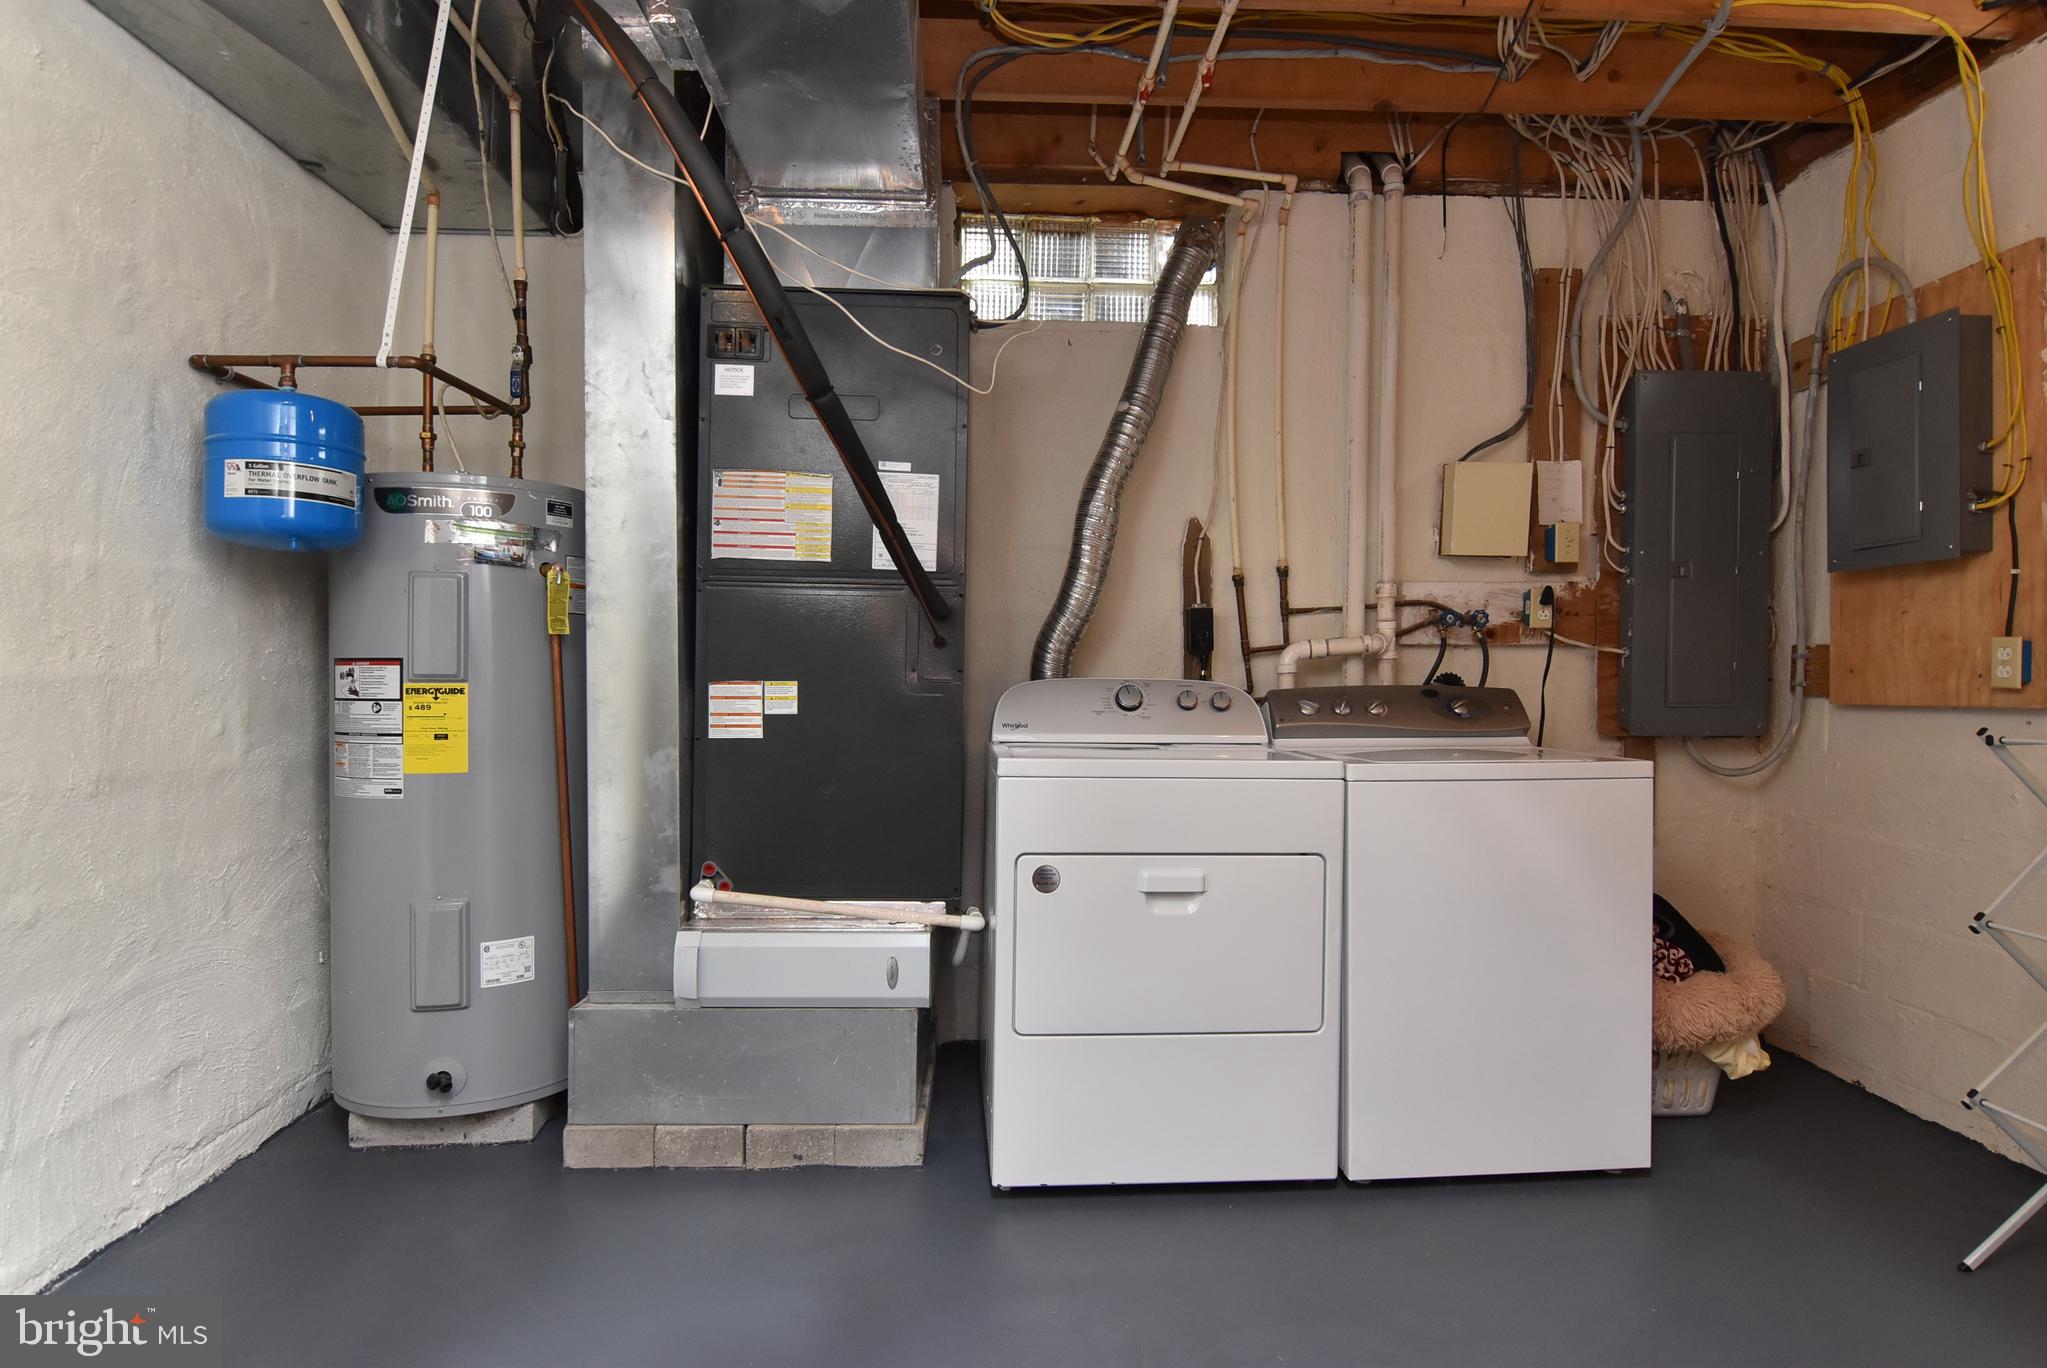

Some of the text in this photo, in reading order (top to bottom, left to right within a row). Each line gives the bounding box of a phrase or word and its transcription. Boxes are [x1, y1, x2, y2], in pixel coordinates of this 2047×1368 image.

[322, 477, 338, 485] TANK
[470, 505, 493, 518] 100
[1001, 721, 1029, 731] Whirlpool
